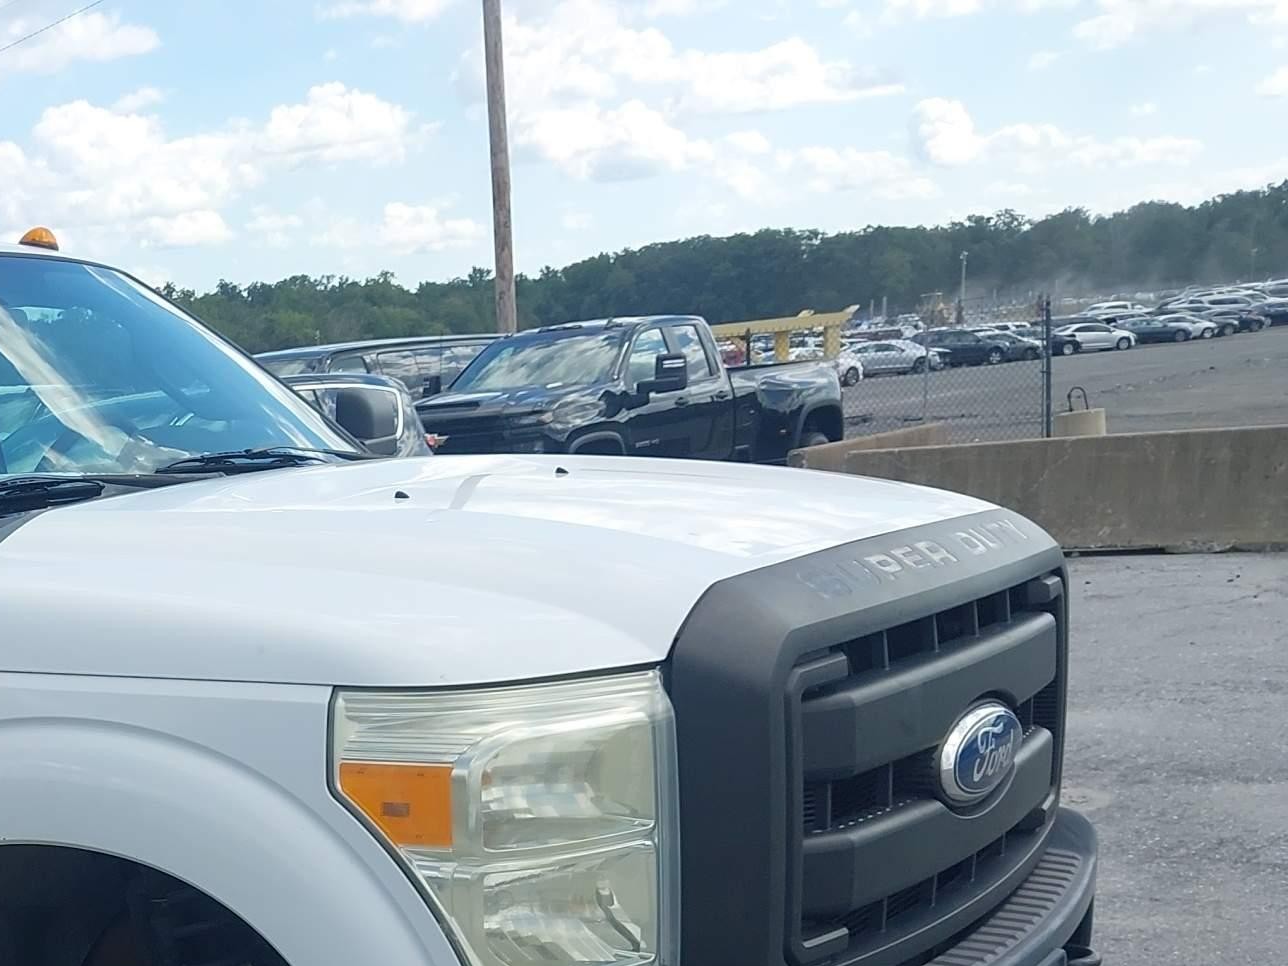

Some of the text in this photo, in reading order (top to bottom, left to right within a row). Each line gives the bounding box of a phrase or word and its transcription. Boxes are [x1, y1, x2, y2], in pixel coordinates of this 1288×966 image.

[795, 518, 1029, 600] SUPER DUTY
[973, 721, 1015, 783] Ford
